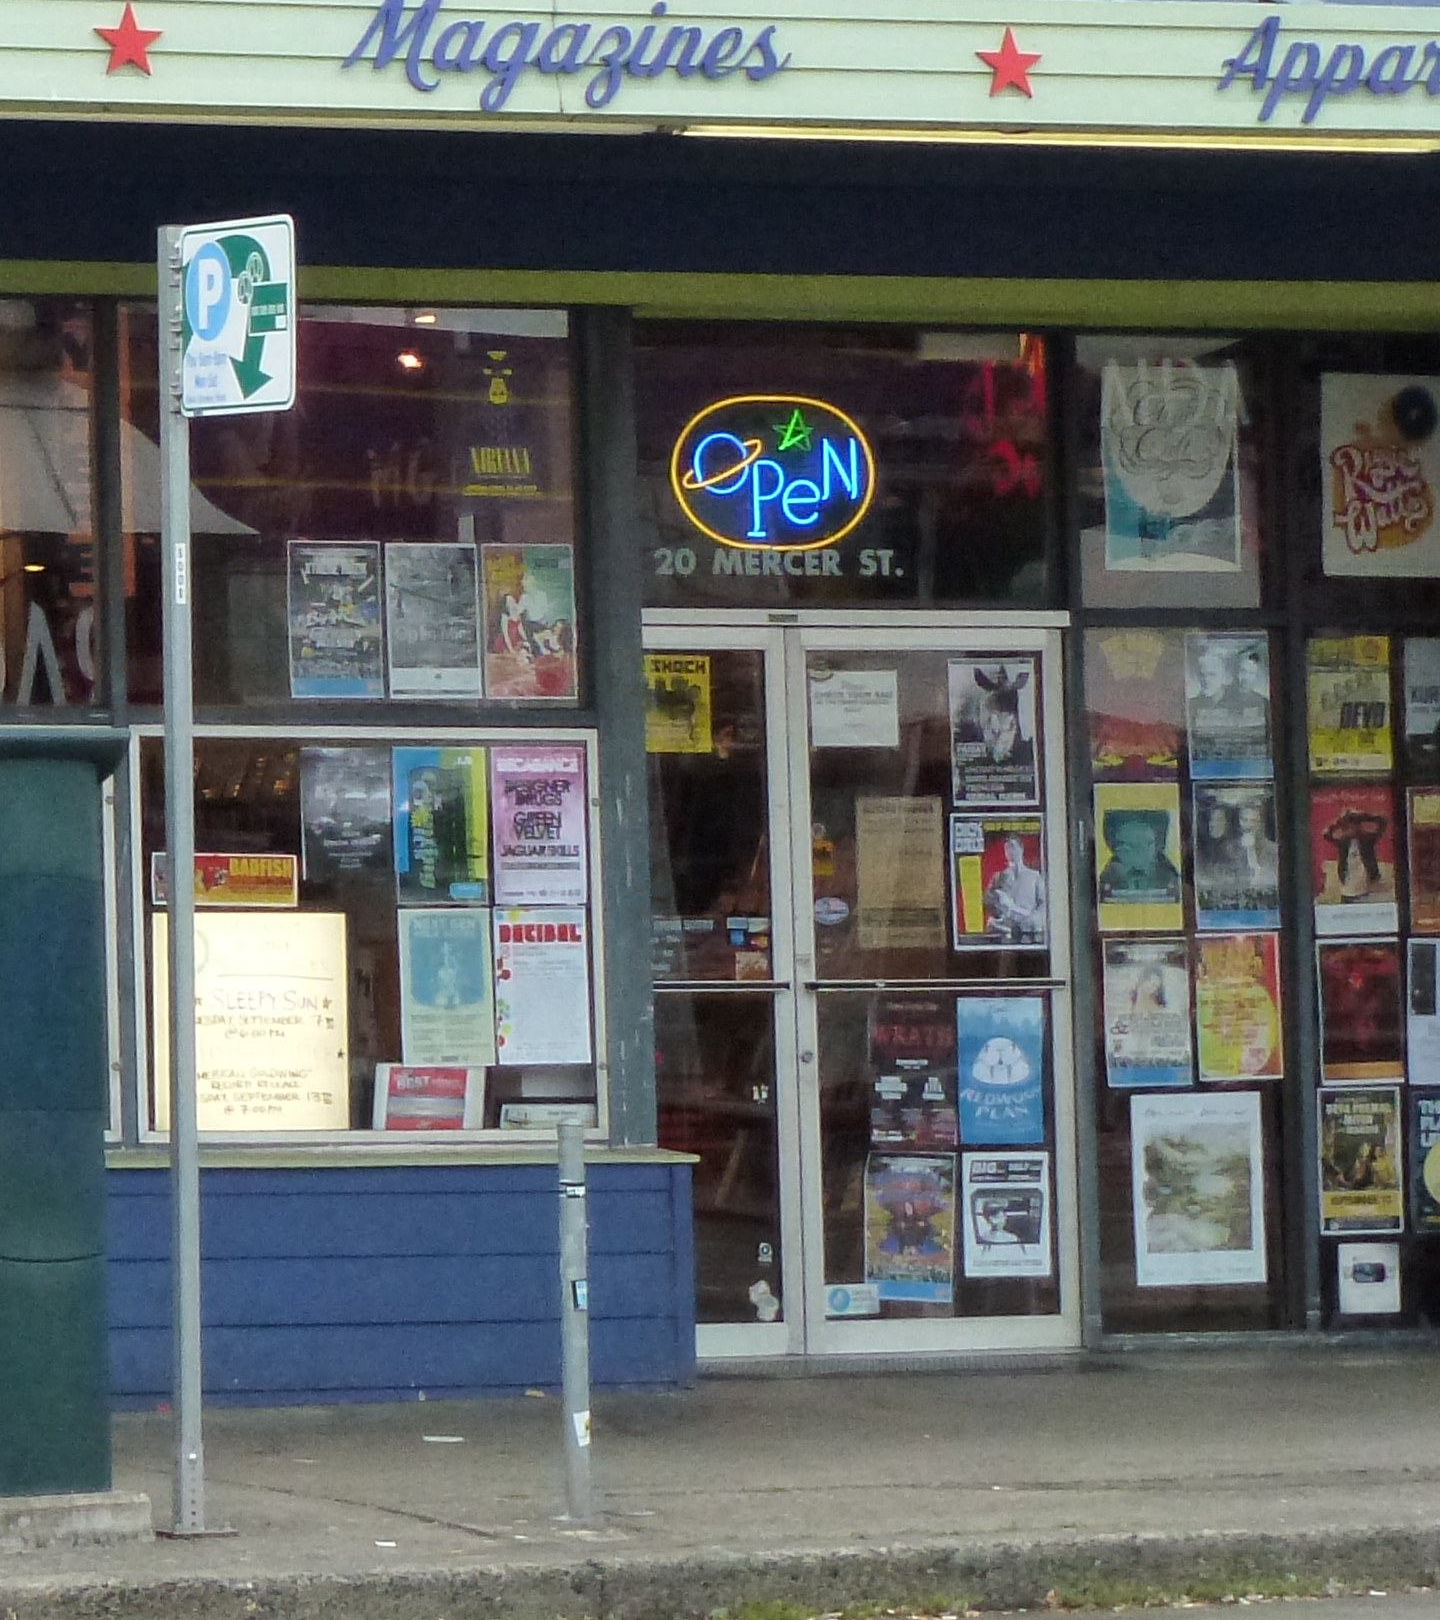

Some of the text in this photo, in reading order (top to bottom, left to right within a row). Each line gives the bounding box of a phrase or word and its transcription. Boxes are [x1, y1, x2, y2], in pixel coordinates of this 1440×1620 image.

[197, 257, 223, 330] P
[653, 547, 905, 578] 20 MERCER ST.
